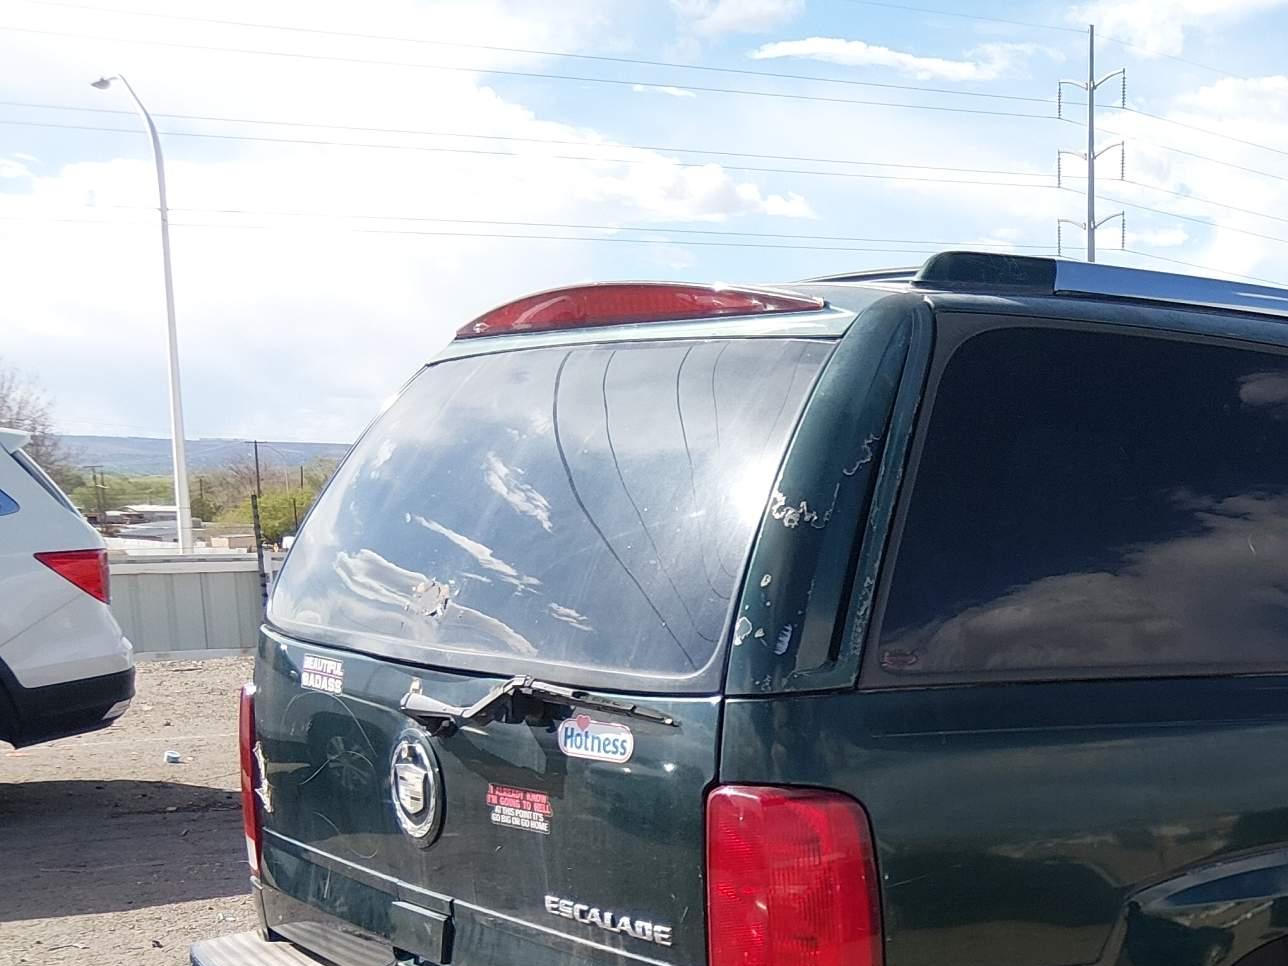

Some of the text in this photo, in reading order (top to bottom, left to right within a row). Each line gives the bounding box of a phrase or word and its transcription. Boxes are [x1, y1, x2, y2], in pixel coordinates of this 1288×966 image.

[301, 671, 342, 693] BADASS
[564, 726, 628, 756] Hotness
[499, 797, 521, 809] GOING
[522, 800, 532, 811] TO
[502, 806, 515, 817] THIS
[515, 808, 533, 820] POINT
[490, 813, 549, 832] GO BIG OR GO HOME
[544, 894, 673, 947] ESCALADE
